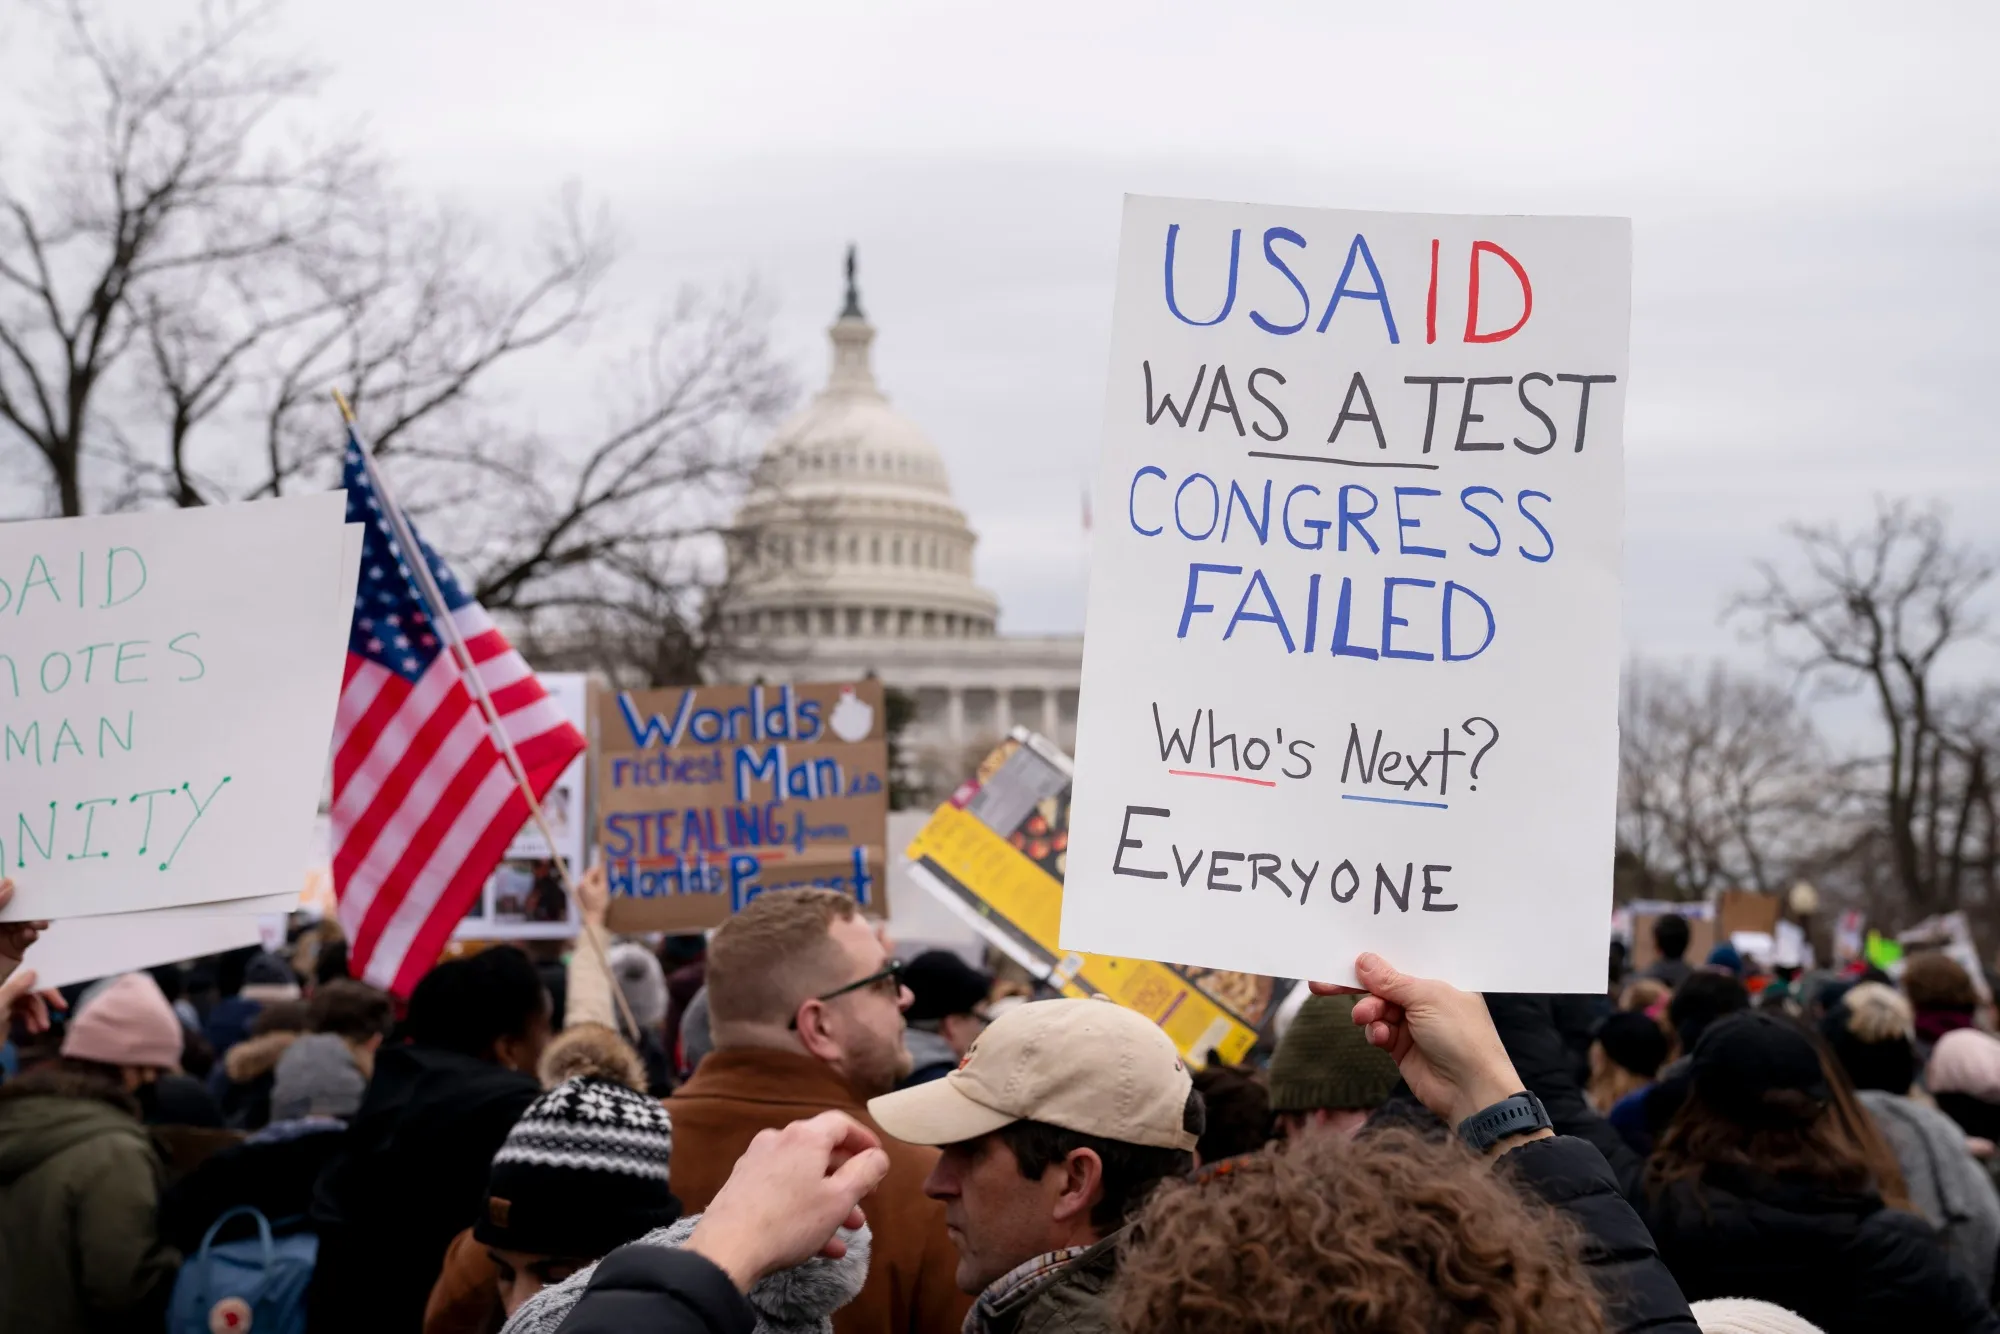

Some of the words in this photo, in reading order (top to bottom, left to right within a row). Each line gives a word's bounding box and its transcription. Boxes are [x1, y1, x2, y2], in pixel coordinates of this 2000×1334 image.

[1164, 223, 1533, 345] USAID
[1143, 360, 1289, 442] WAS
[1327, 371, 1387, 450] A
[1403, 371, 1617, 454] TEST
[1129, 465, 1555, 563] CONGRESS
[1176, 562, 1497, 663] FAILED
[616, 683, 824, 749] Worlds
[1152, 701, 1316, 780] Who's
[1340, 716, 1500, 796] Next?
[612, 750, 723, 788] richest
[733, 743, 846, 803] Man
[0, 776, 232, 878] NITY
[604, 801, 786, 857] STEALING
[1112, 805, 1459, 916] EVERYONE
